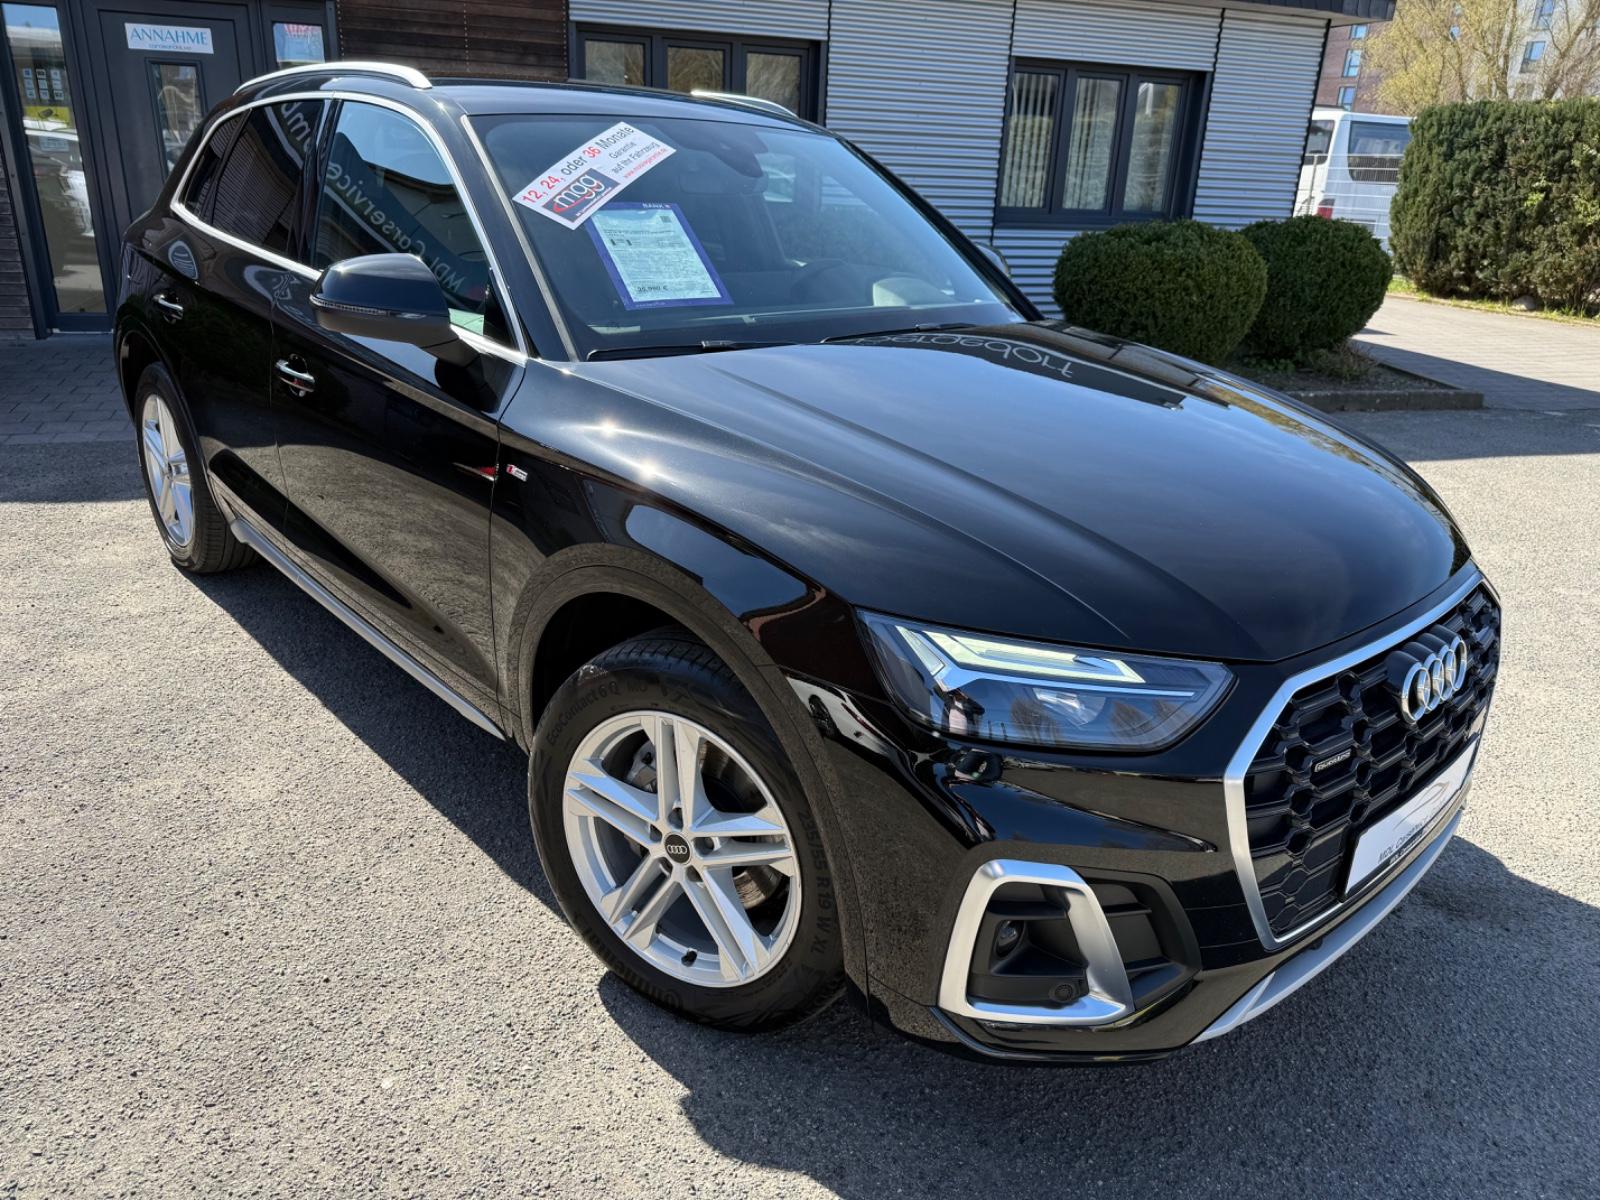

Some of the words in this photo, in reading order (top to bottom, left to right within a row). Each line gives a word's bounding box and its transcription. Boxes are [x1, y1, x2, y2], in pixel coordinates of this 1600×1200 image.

[130, 27, 209, 45] ANNAHME
[560, 154, 588, 176] oder
[583, 146, 602, 159] 36
[596, 125, 635, 150] Monate
[609, 141, 637, 159] Garantie
[612, 162, 625, 174] auf
[631, 142, 661, 161] Fahrzeug
[553, 173, 605, 209] mgg
[599, 685, 608, 698] 6
